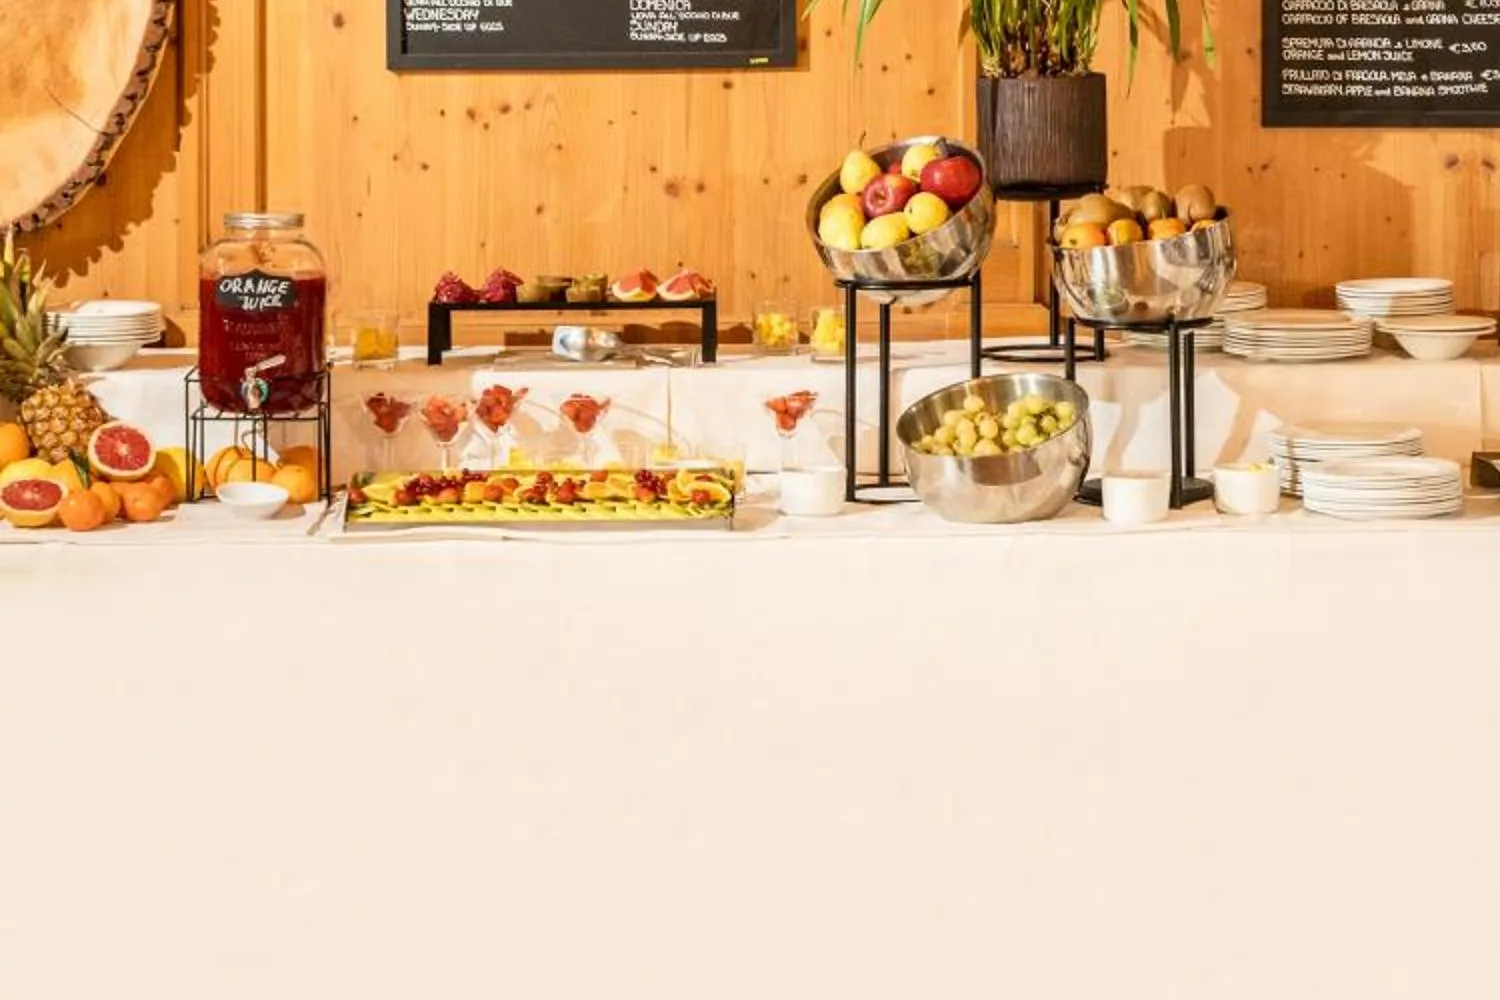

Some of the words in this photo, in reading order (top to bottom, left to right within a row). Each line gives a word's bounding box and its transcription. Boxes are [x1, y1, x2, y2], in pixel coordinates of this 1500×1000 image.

[1281, 0, 1335, 11] CARPACCIO
[1349, 0, 1399, 11] BRESAOLA
[403, 7, 480, 21] WEDNESDAY
[1281, 13, 1334, 25] CARPACCIO
[1335, 13, 1349, 25] OF
[1351, 13, 1402, 25] BRESAOLA
[1425, 13, 1459, 25] GRANA
[630, 19, 679, 33] SUNDAY
[1281, 37, 1335, 49] SPREMUTA
[1404, 38, 1444, 49] LIMONE
[1281, 49, 1325, 61] ORANGE
[1345, 50, 1381, 61] LEMON
[1383, 50, 1415, 61] JUICE
[1281, 68, 1331, 81] FRULLATO
[1429, 71, 1473, 81] BANANA
[1345, 85, 1373, 97] APPLE
[1393, 85, 1435, 97] BANANA
[1437, 82, 1488, 96] SMOOTHIE
[219, 277, 291, 294] ORANGE
